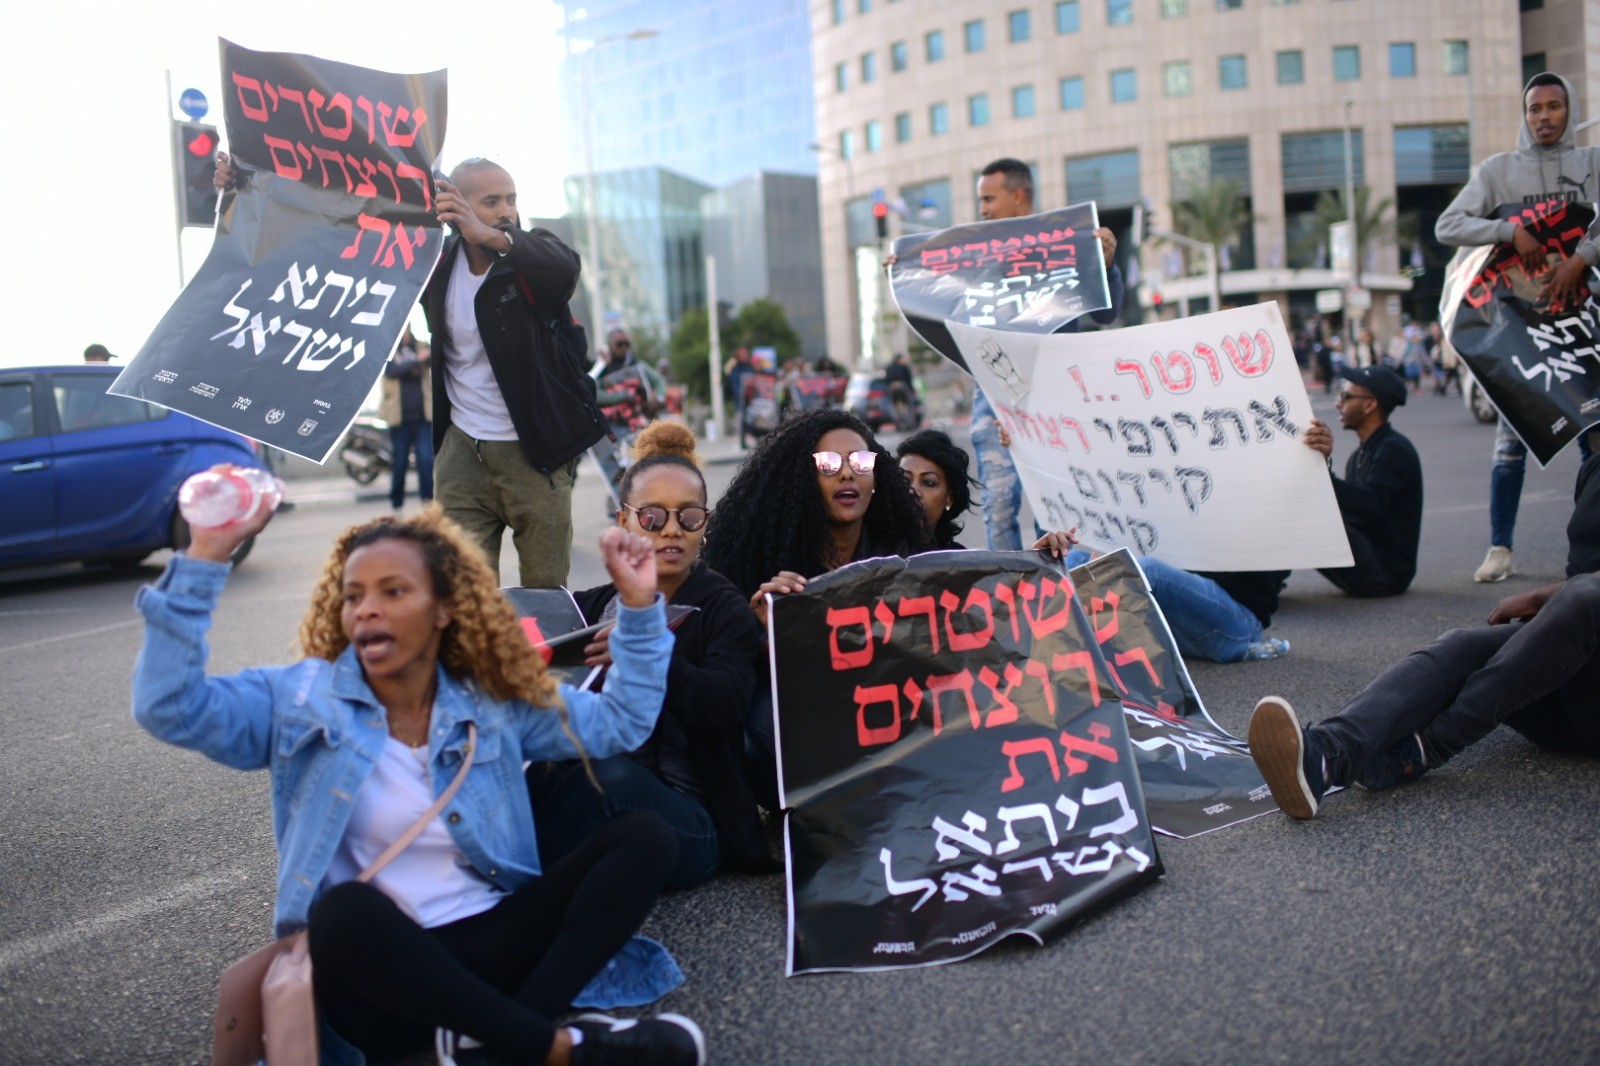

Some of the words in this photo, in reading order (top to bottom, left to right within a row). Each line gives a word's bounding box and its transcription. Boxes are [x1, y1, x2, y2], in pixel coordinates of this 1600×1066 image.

[233, 71, 428, 147] שוטרים
[264, 133, 432, 212] רוצחים
[340, 212, 427, 269] את
[209, 277, 366, 372] ישראל
[268, 261, 397, 327] ביתא
[1068, 464, 1214, 517] קידום
[825, 577, 1075, 671] שוטרים
[853, 650, 1101, 747] רוצחים
[1001, 721, 1119, 793] את
[931, 781, 1139, 862] ביתא
[879, 840, 1151, 913] ישראל
